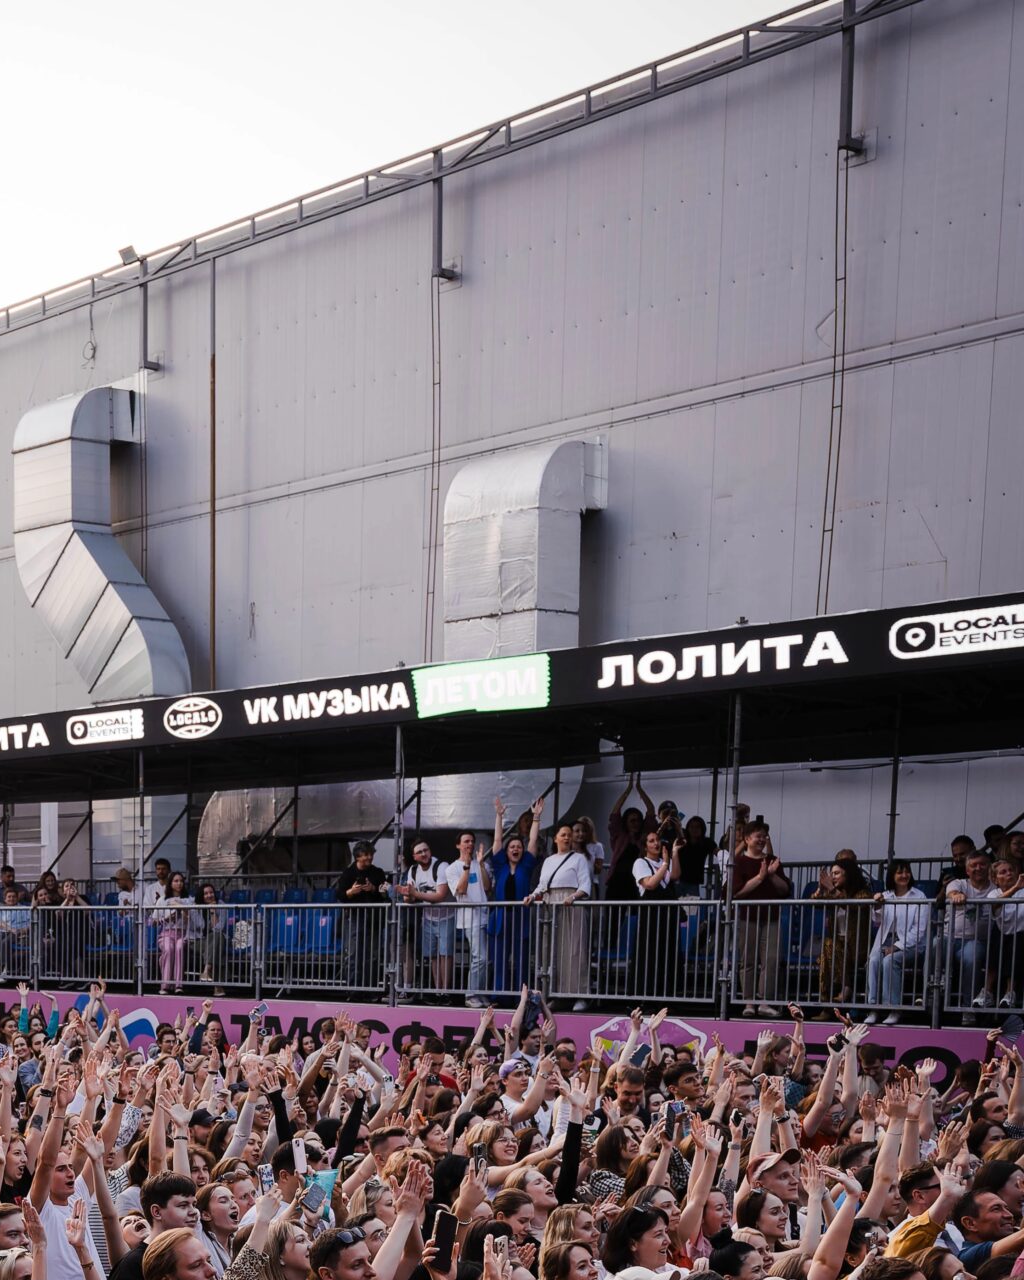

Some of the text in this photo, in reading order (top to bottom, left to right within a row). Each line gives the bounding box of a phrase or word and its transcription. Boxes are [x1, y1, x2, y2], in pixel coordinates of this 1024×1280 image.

[939, 614, 1024, 633] LOCAL
[939, 628, 1024, 647] EVENTS
[597, 630, 849, 689] ЛОЛИТА
[424, 667, 537, 706] ЛЕТОМ
[243, 682, 410, 724] VK МУЗЫКА
[89, 717, 128, 728] LOCAL
[169, 709, 216, 727] LOCALS
[89, 727, 129, 737] EVENTS
